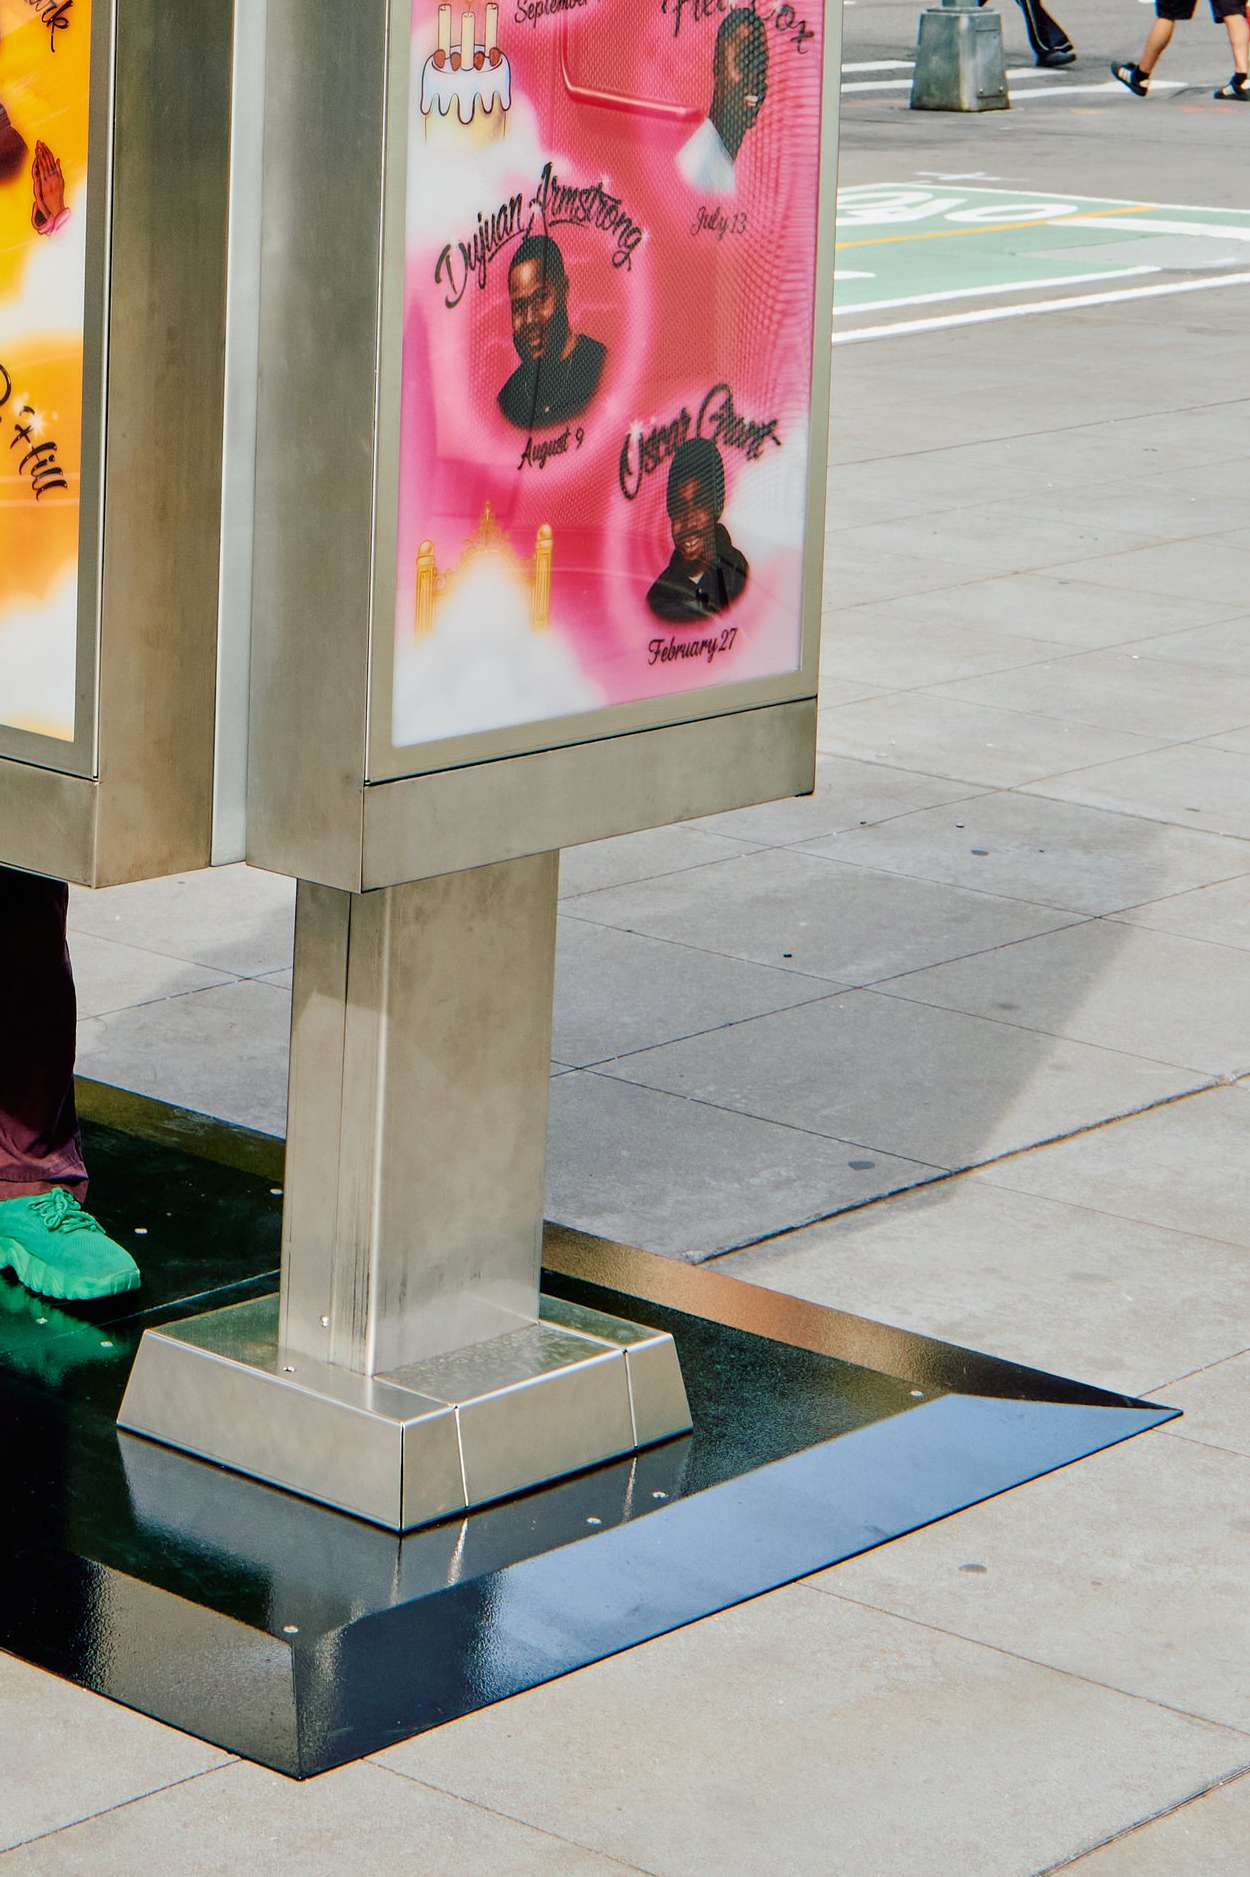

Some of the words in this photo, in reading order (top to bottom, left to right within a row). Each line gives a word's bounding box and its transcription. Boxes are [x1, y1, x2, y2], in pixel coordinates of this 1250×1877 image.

[434, 193, 526, 309] Dujuan
[524, 161, 645, 273] Armstrong
[10, 406, 68, 502] Hill
[517, 429, 571, 471] August
[576, 430, 585, 450] 9
[647, 632, 721, 666] February
[719, 627, 738, 652] 27
